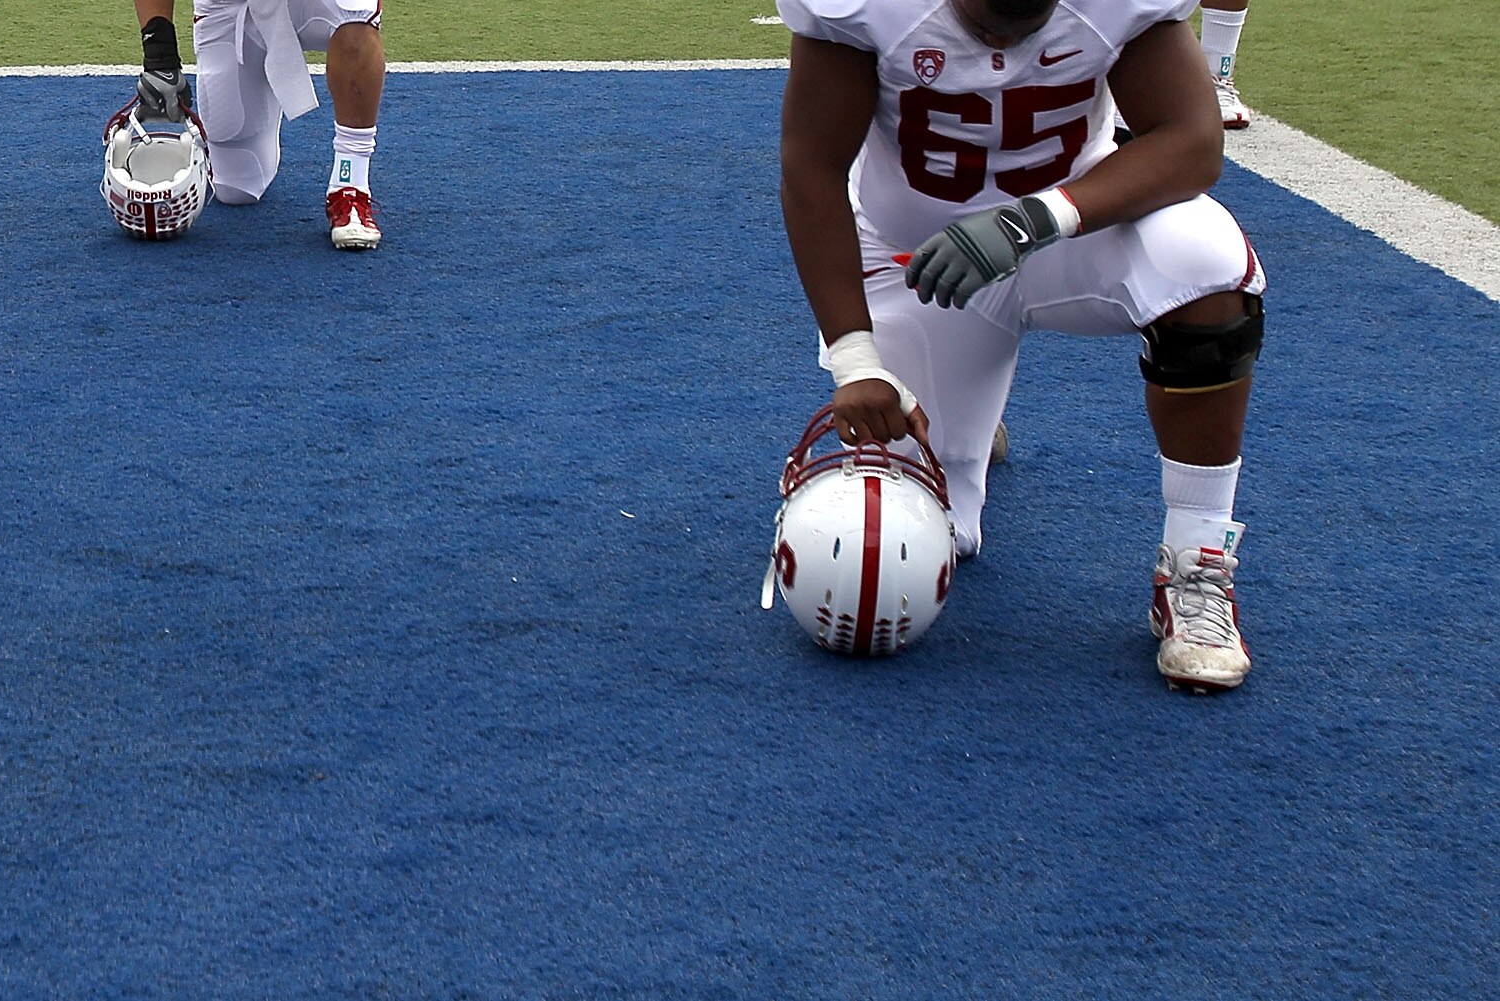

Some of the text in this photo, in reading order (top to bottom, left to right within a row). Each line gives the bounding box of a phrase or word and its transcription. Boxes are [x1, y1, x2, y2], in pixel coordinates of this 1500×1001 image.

[990, 51, 1006, 72] S
[897, 77, 1097, 204] 65
[127, 189, 172, 202] Riddell
